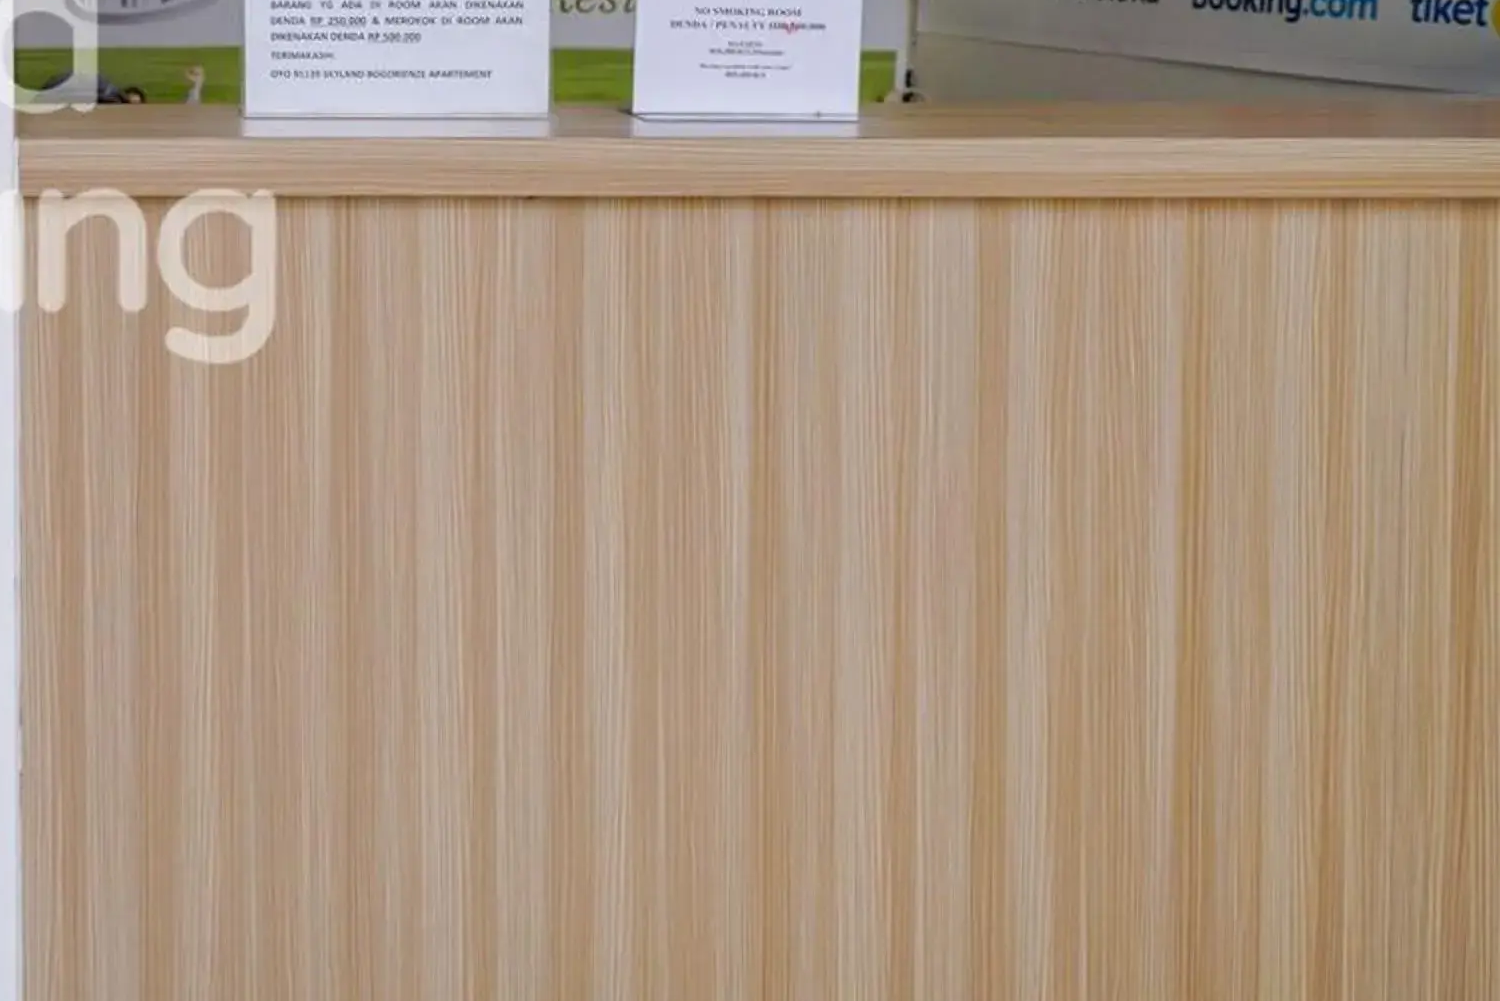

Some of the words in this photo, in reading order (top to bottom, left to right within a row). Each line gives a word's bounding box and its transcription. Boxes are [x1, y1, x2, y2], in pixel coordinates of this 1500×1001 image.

[270, 0, 312, 10] BARANG
[341, 0, 363, 10] ADA
[388, 0, 421, 10] ROOM
[428, 0, 457, 10] AKAN
[270, 16, 306, 27] DENDA
[440, 16, 453, 27] DI
[457, 16, 490, 27] ROOM
[495, 16, 524, 27] AKAN
[270, 32, 328, 43] DIKENAKAN
[330, 32, 366, 43] DENDA
